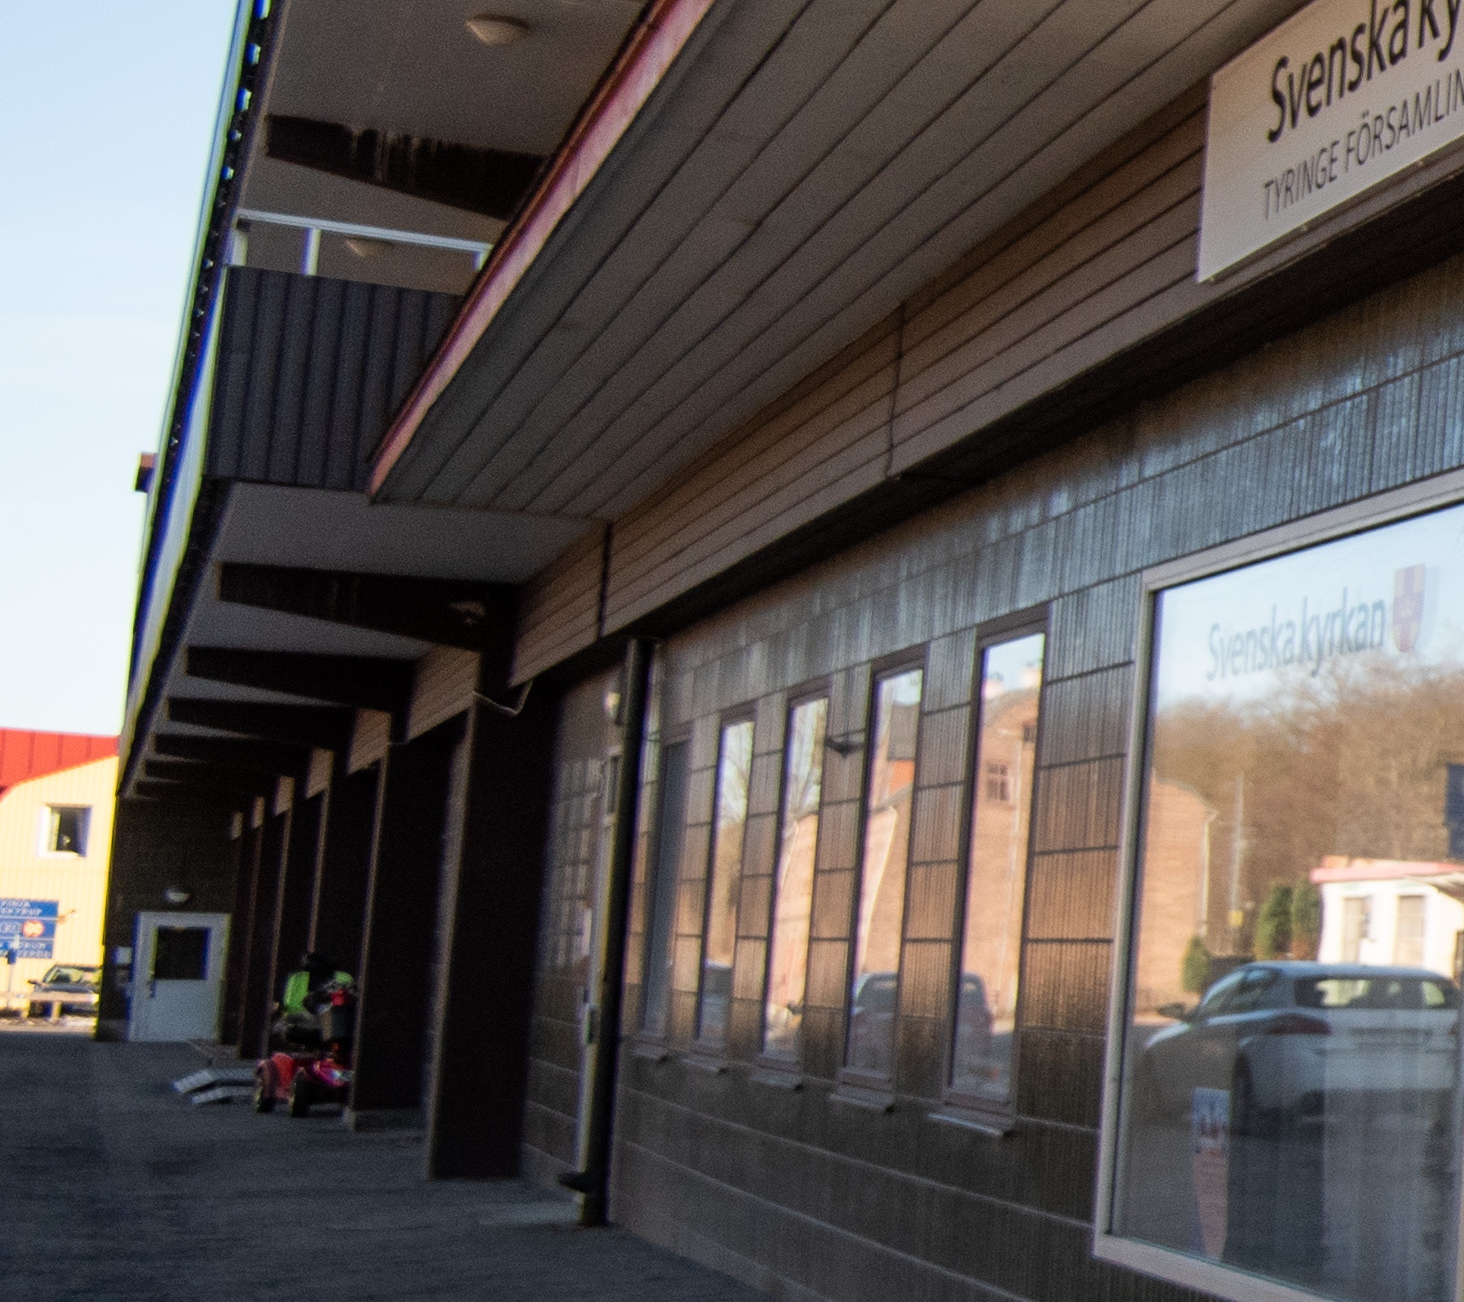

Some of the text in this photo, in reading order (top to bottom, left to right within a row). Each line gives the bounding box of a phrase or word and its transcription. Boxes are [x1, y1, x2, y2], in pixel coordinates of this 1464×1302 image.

[1261, 141, 1340, 220] TYRINGE
[1206, 586, 1387, 681] Svenska kyrkan
